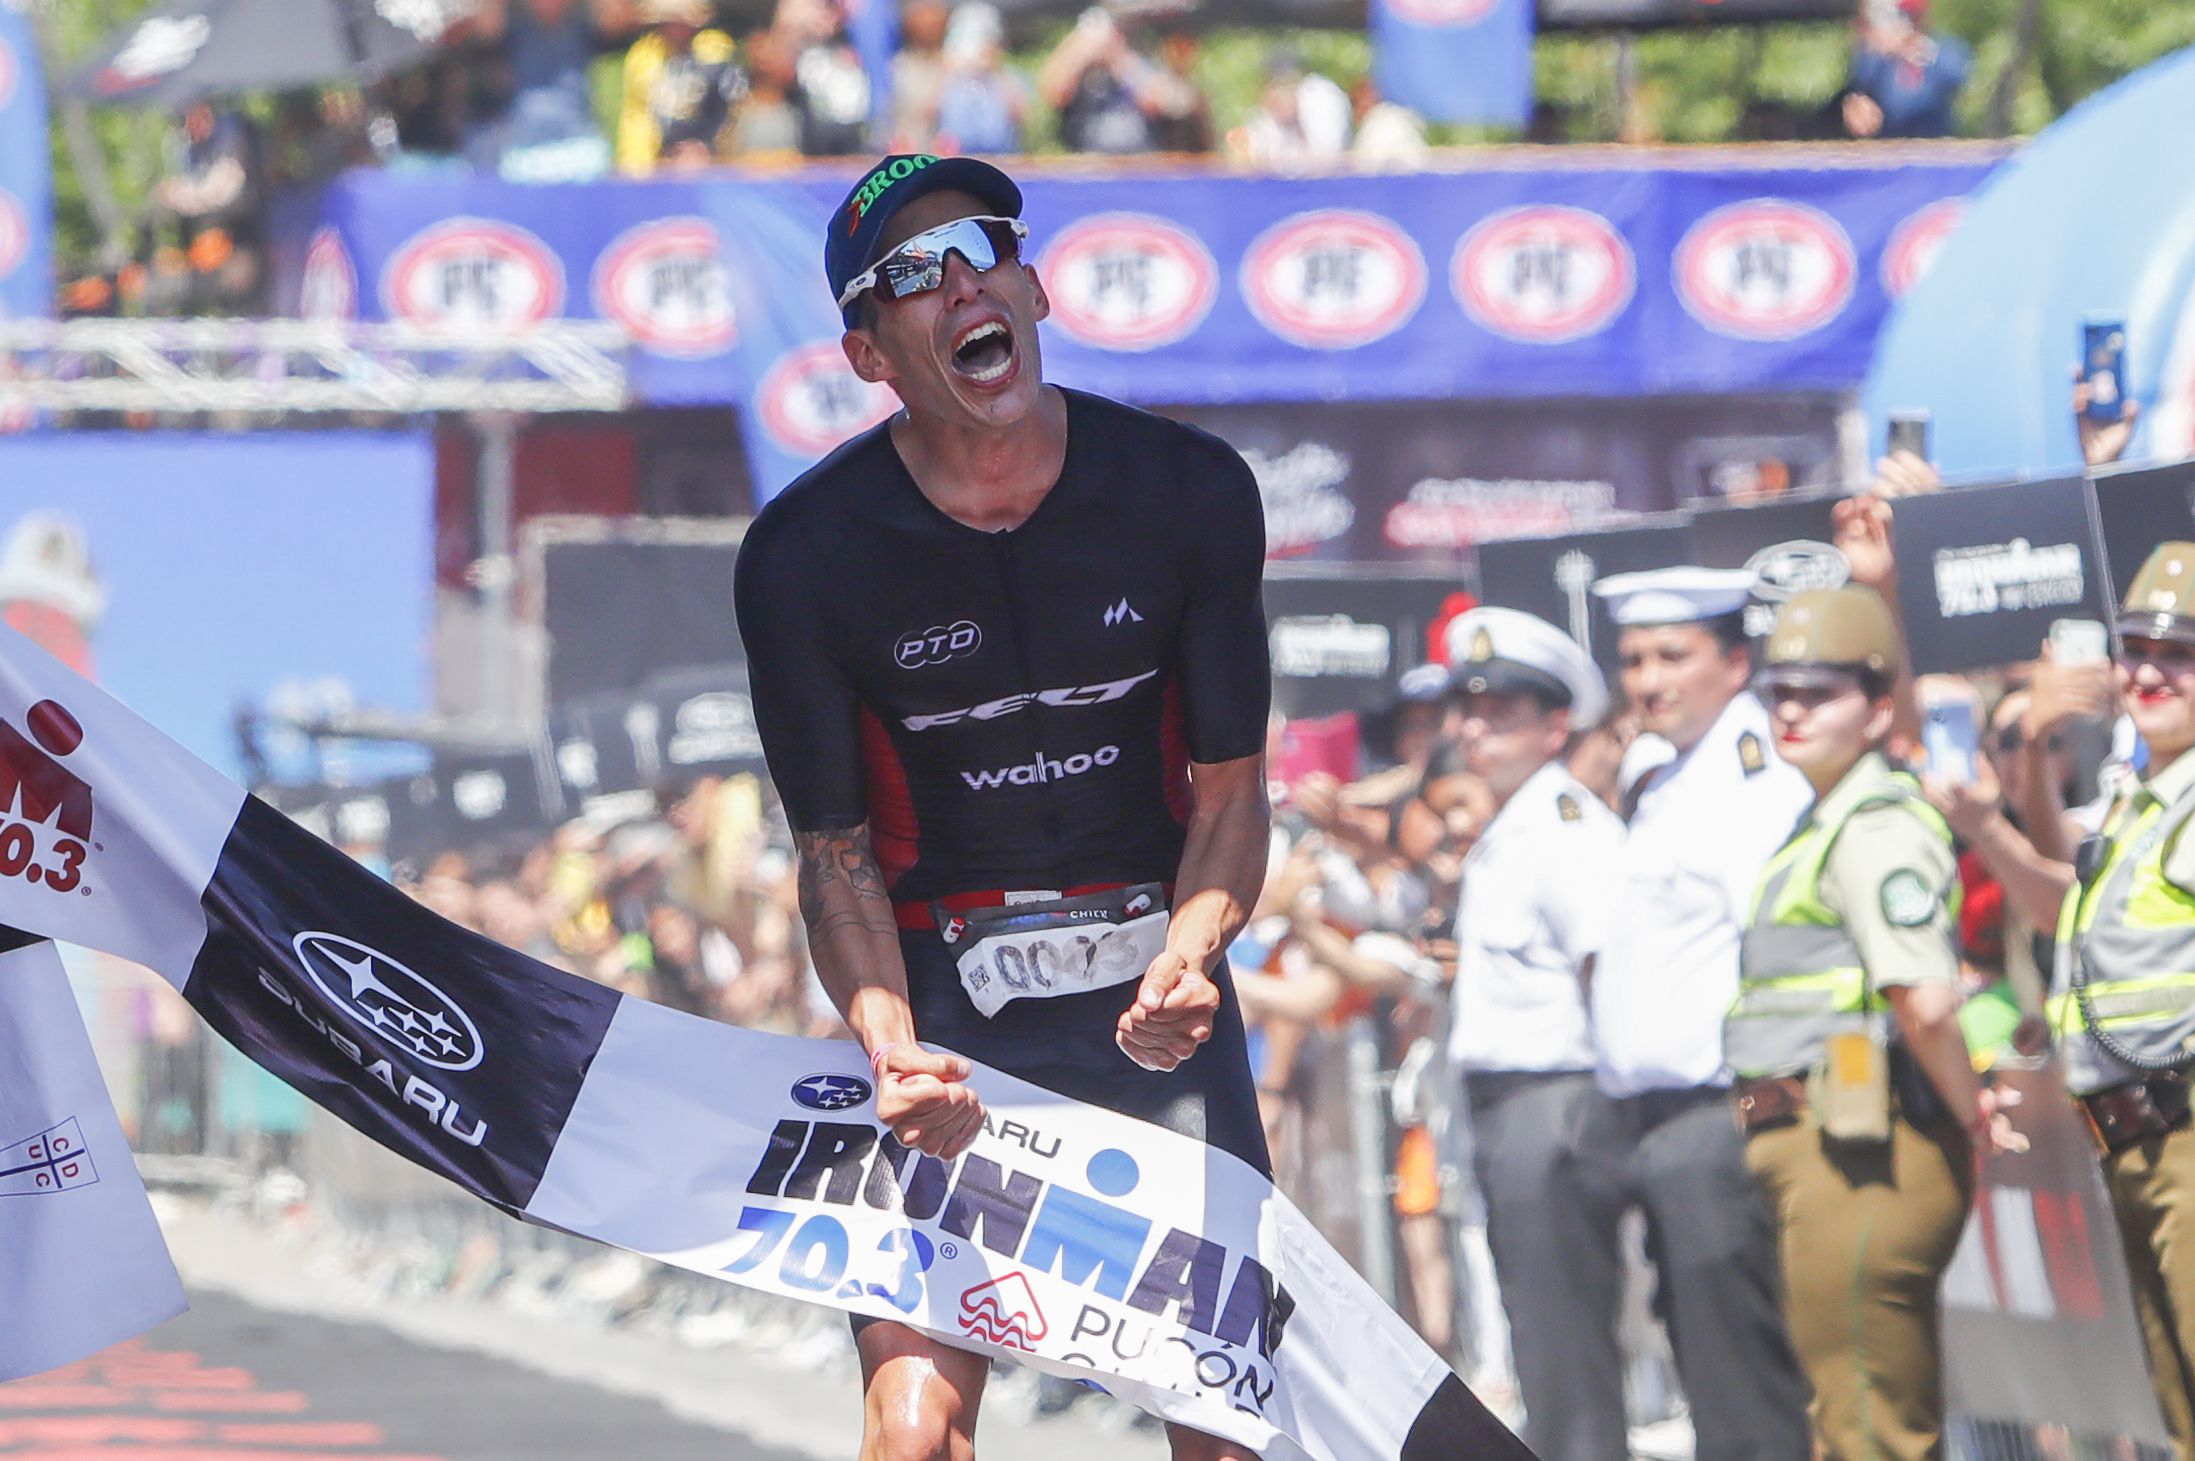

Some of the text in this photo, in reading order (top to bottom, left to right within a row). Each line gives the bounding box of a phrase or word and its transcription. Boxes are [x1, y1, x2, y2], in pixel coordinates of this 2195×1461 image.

[901, 668, 1159, 731] FELT
[960, 745, 1120, 790] wahoo
[0, 819, 86, 892] 0.3
[258, 966, 488, 1147] SUBARU
[980, 1107, 1063, 1159] ARU
[745, 1118, 1296, 1366] IRONMAN
